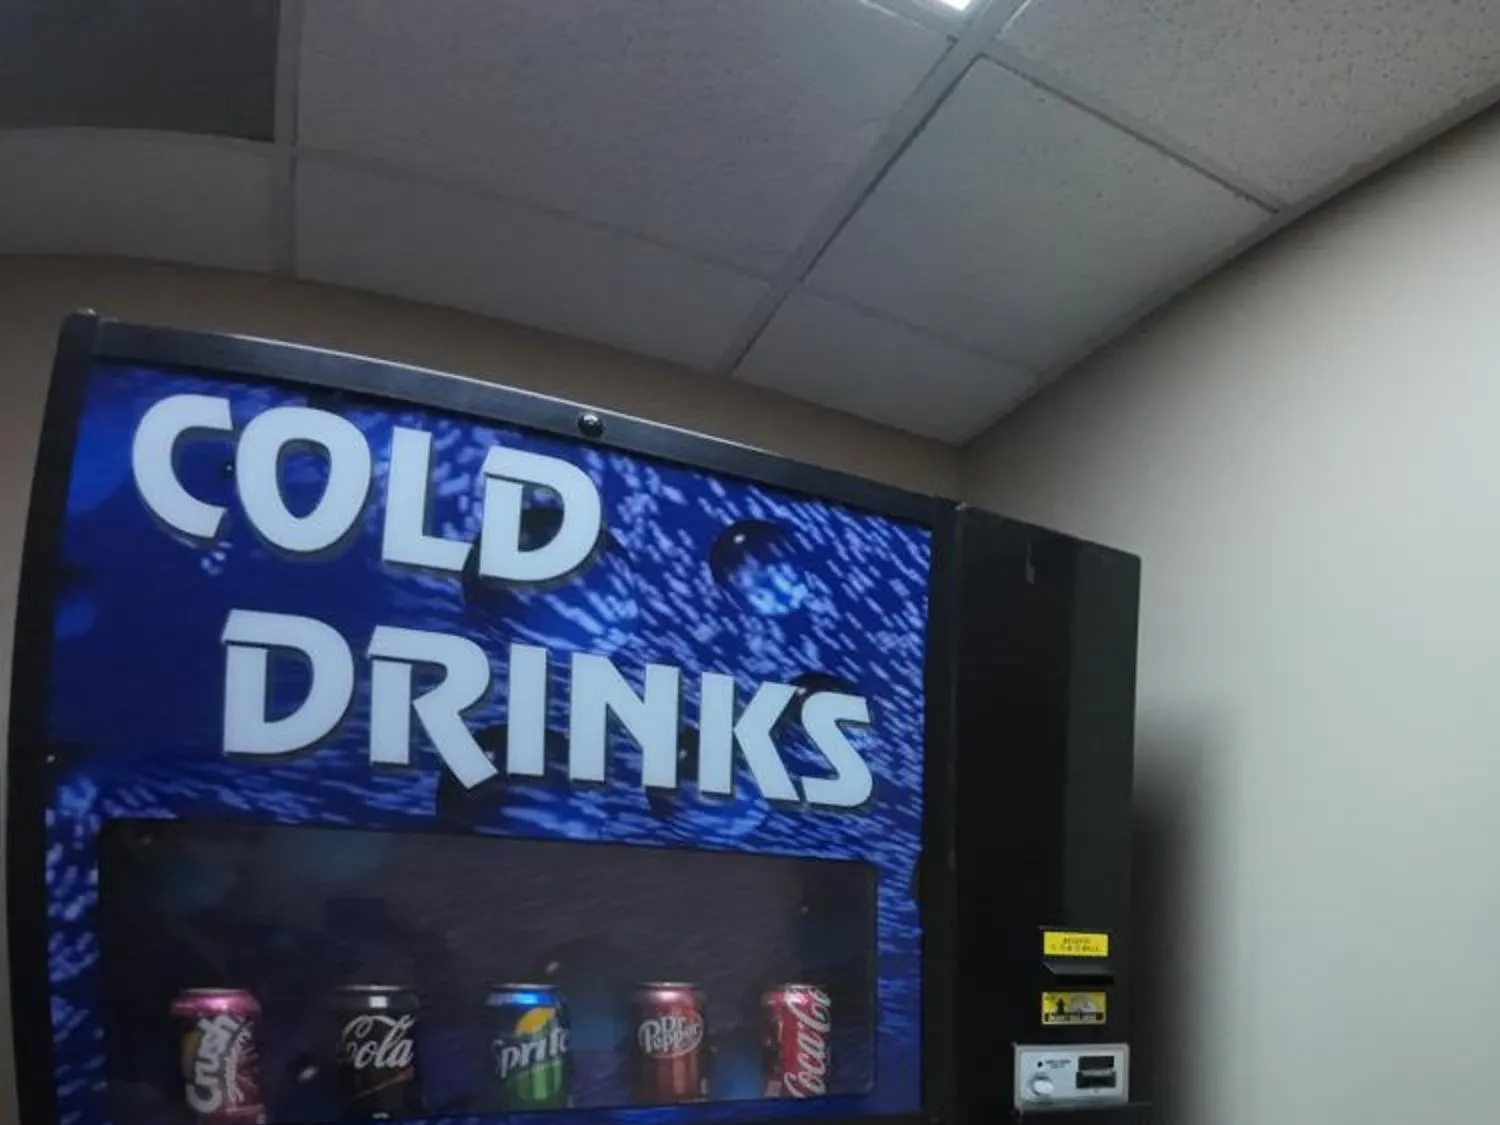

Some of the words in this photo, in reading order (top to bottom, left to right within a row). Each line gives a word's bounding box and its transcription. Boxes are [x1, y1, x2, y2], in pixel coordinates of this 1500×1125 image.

[132, 394, 601, 582] COLD
[221, 608, 874, 809] DRINKS
[185, 1014, 239, 1113] Crush
